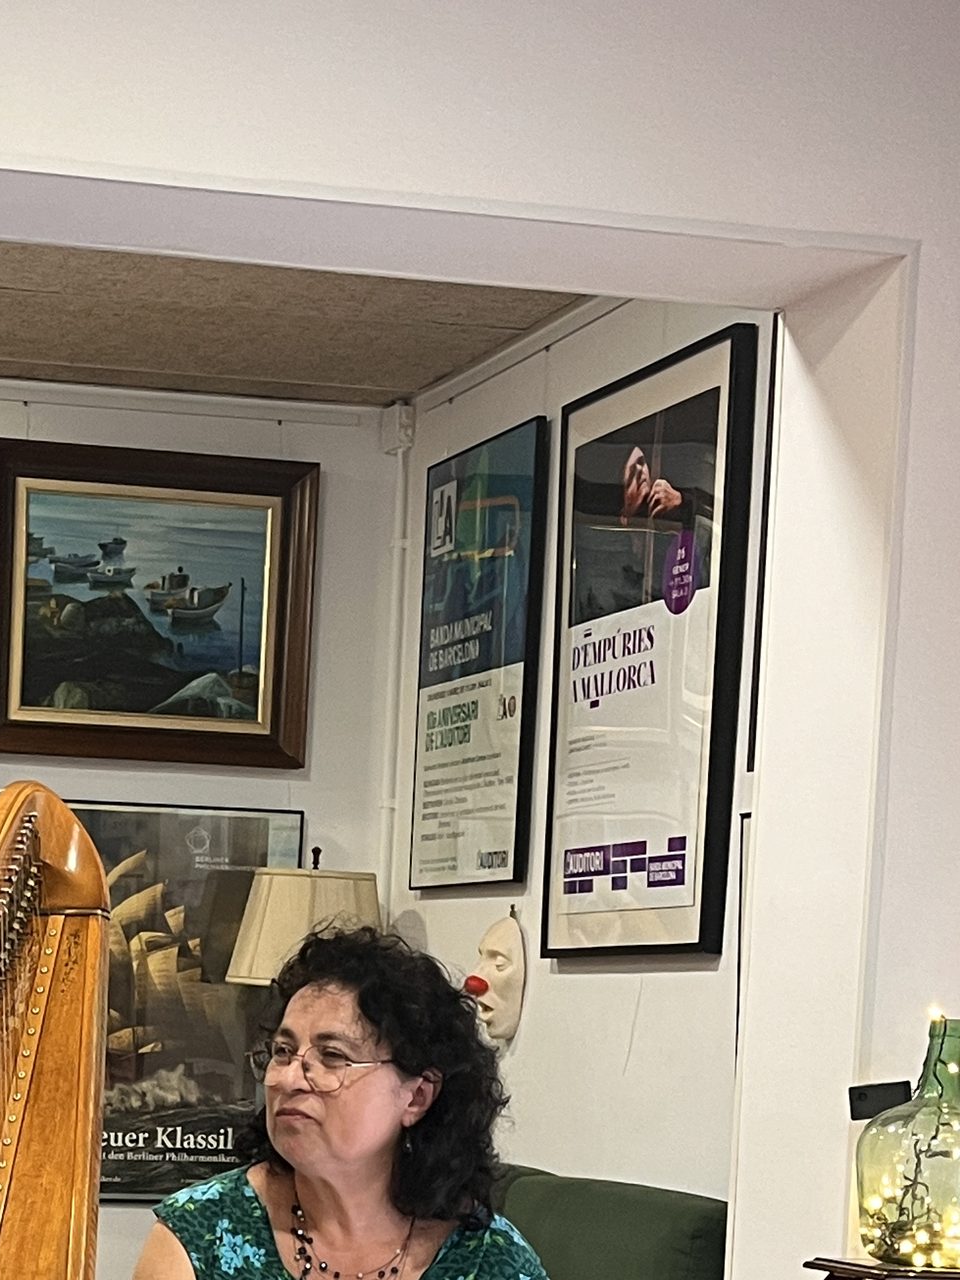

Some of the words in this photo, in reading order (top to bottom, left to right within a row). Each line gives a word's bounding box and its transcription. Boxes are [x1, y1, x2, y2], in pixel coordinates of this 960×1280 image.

[572, 624, 655, 671] D'EMPÚRIES
[580, 660, 656, 701] MALLORCA
[127, 1151, 164, 1161] Berliner
